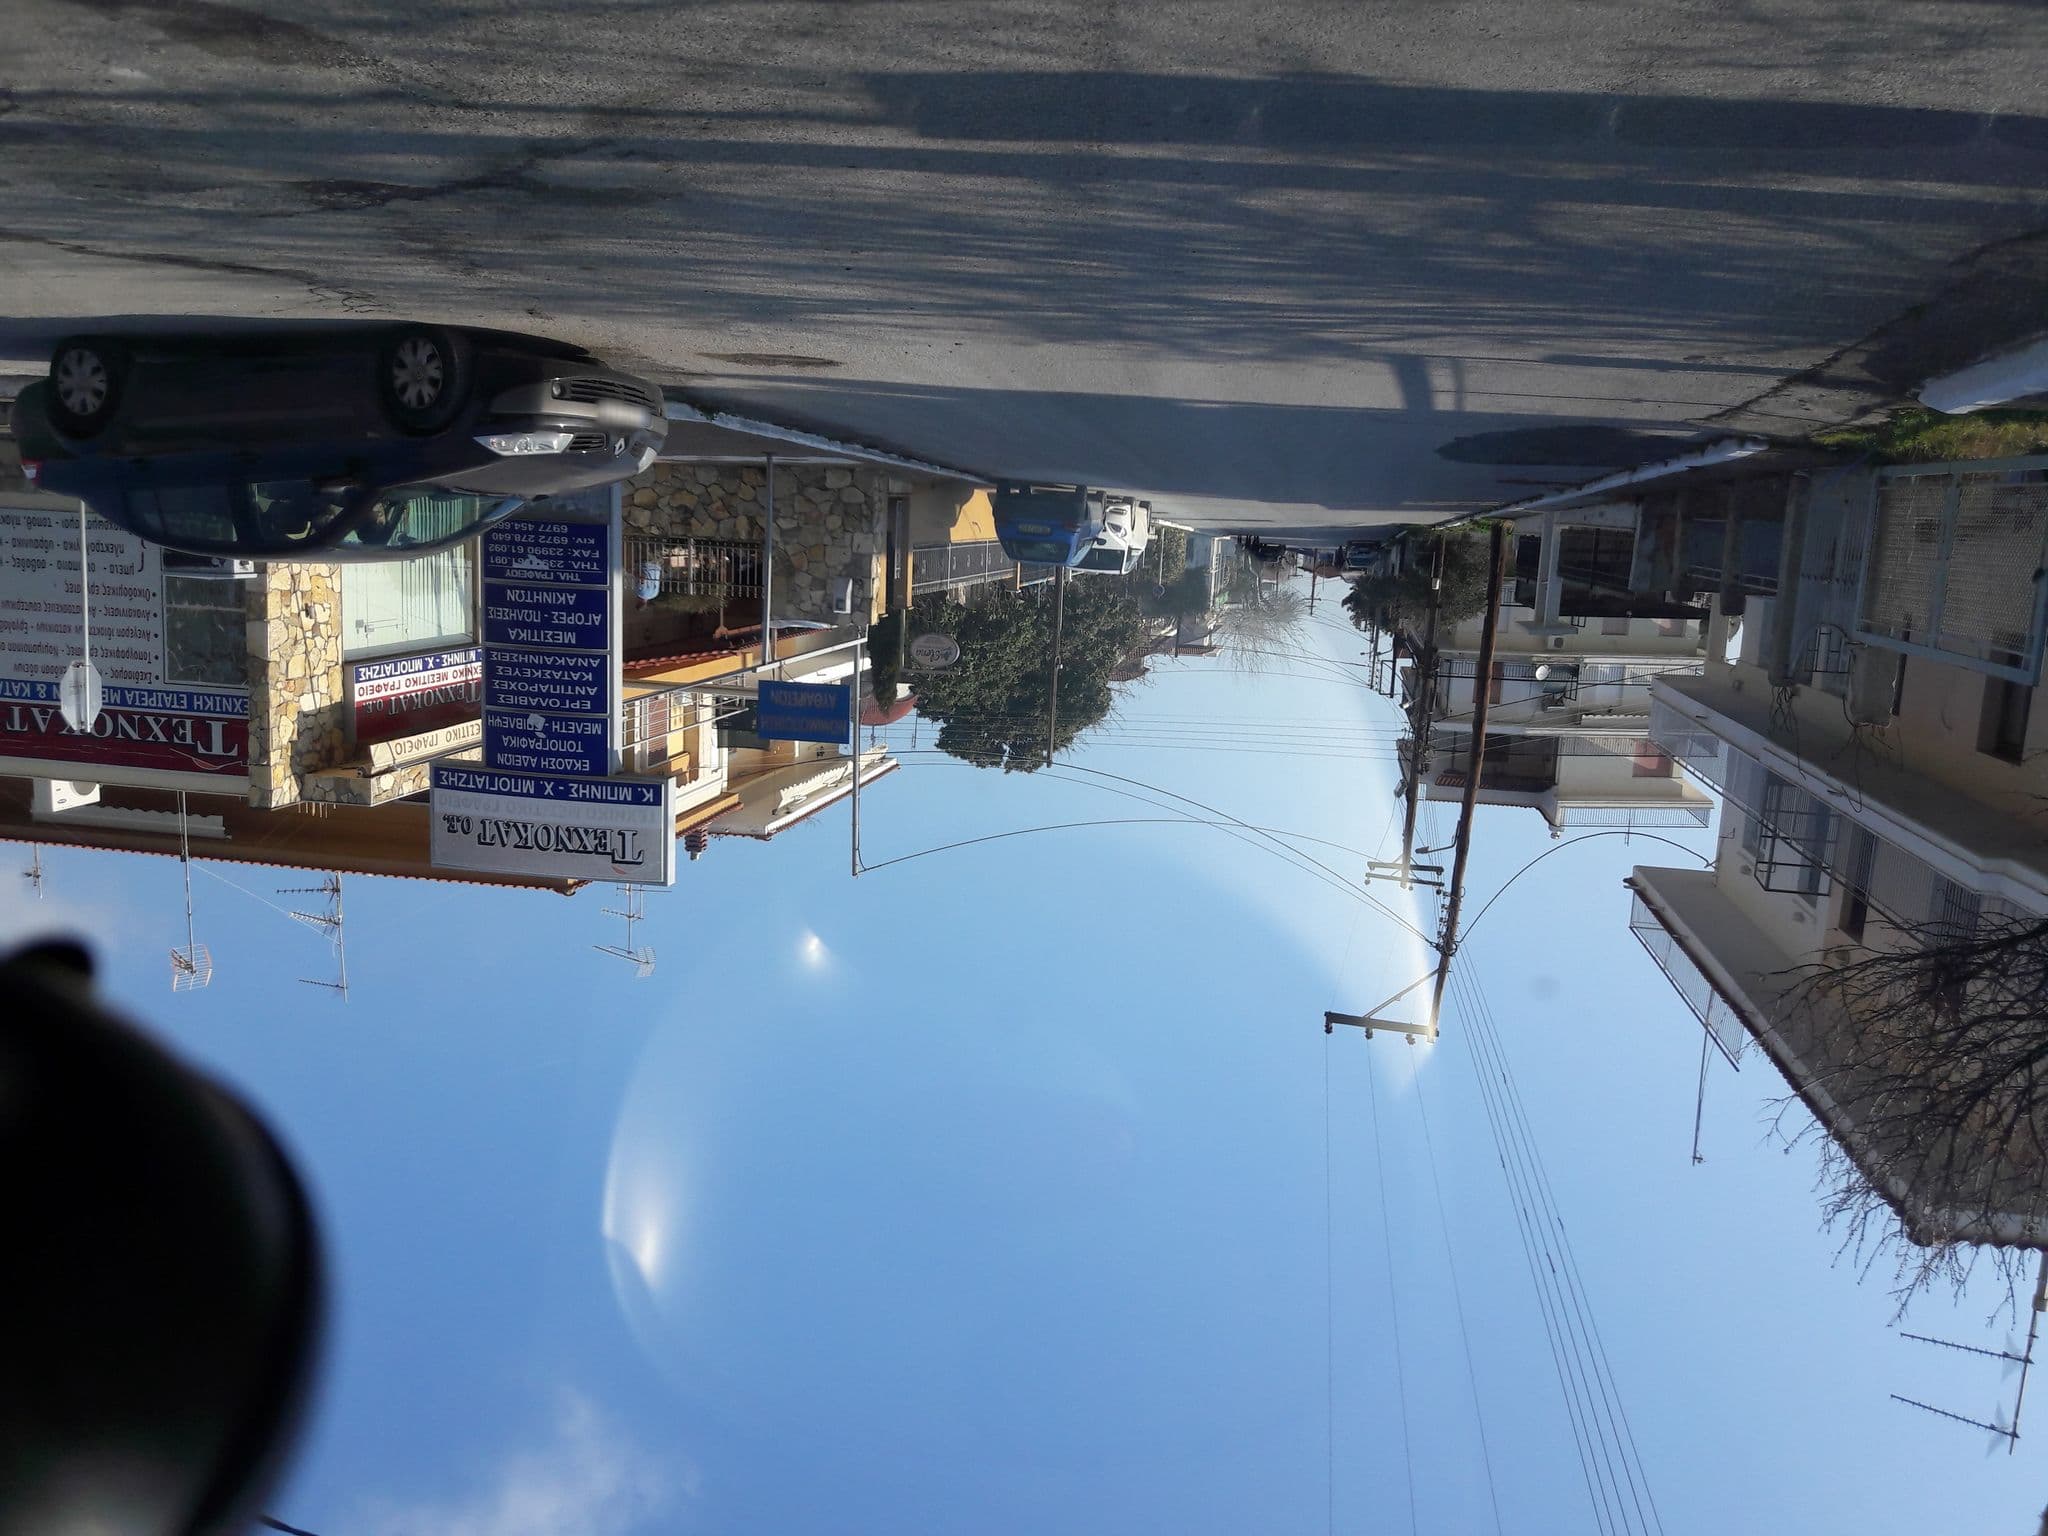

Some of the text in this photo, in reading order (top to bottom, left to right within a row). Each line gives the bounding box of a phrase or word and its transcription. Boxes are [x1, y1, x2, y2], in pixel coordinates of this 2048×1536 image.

[538, 524, 568, 533] 6977
[492, 532, 535, 543] 278.640
[538, 535, 568, 545] 6972
[488, 543, 600, 558] FAX: 23990 61.092
[568, 560, 600, 570] ΤΗΛ.
[506, 589, 577, 605] ΑΚΙΝΗΤΩΝ
[488, 606, 541, 622] ΠΩΛΗΣΕΙΣ
[551, 611, 602, 626] ΑΓΟΡΕΣ
[507, 628, 576, 644] ΜΕΣΙΤΙΚΑ
[441, 649, 476, 666] ΜΠΙΝΗΣ
[489, 650, 601, 668] ΑΝΑΚΑΙΝΗΣΕΙΣ
[358, 660, 423, 681] ΜΠΟΓΙΑΤΖΗΣ
[495, 665, 593, 681] ΚΑΤΑΣΚΕΥΕΣ
[404, 671, 448, 688] ΜΕΣΙΤΙΚΟ
[492, 679, 598, 695] ΑΝΤΙΠΑΡΟΧΕΣ
[36, 684, 47, 699] &
[358, 680, 401, 697] ΓΡΑΦΕΙΟ
[124, 689, 188, 709] ΕΤΑΙΡΕΙΑ
[388, 681, 481, 715] ΤΕΧΝΟΚΑΤ
[496, 693, 591, 710] ΕΡΓΟΛΑΒΙΕΣ
[552, 720, 602, 735] ΜΕΛΕΤΗ
[394, 732, 439, 756] ΓΡΑΦΕΙΟ
[502, 735, 584, 753] ΤΟΠΟΓΡΑΦΙΚΑ
[497, 752, 590, 771] ΕΚΔΟΣΗ ΑΔΕΙΩΝ
[439, 770, 535, 794] ΜΠΟΓΙΑΤΖΗΣ
[539, 781, 555, 795] Χ.
[568, 783, 632, 800] ΜΠΙΝΗΣ
[637, 787, 654, 802] Κ.
[477, 819, 645, 865] ΤΕΧΝΟΚΑΤ
